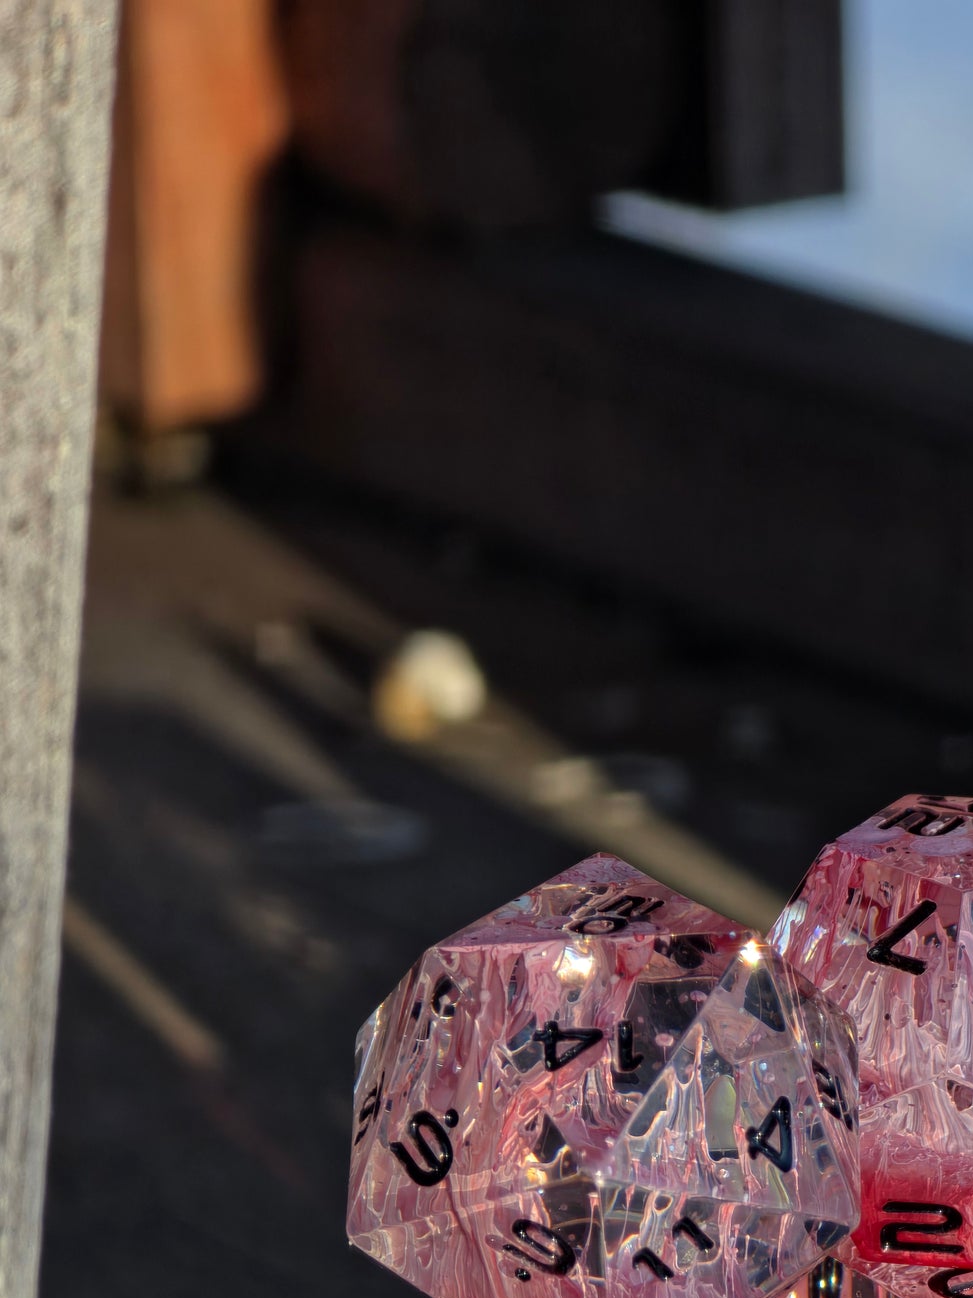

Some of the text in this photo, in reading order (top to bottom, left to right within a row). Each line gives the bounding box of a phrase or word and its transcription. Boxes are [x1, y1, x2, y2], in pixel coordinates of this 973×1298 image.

[867, 900, 937, 976] 7
[746, 1096, 792, 1173] 4
[880, 1201, 964, 1254] 2
